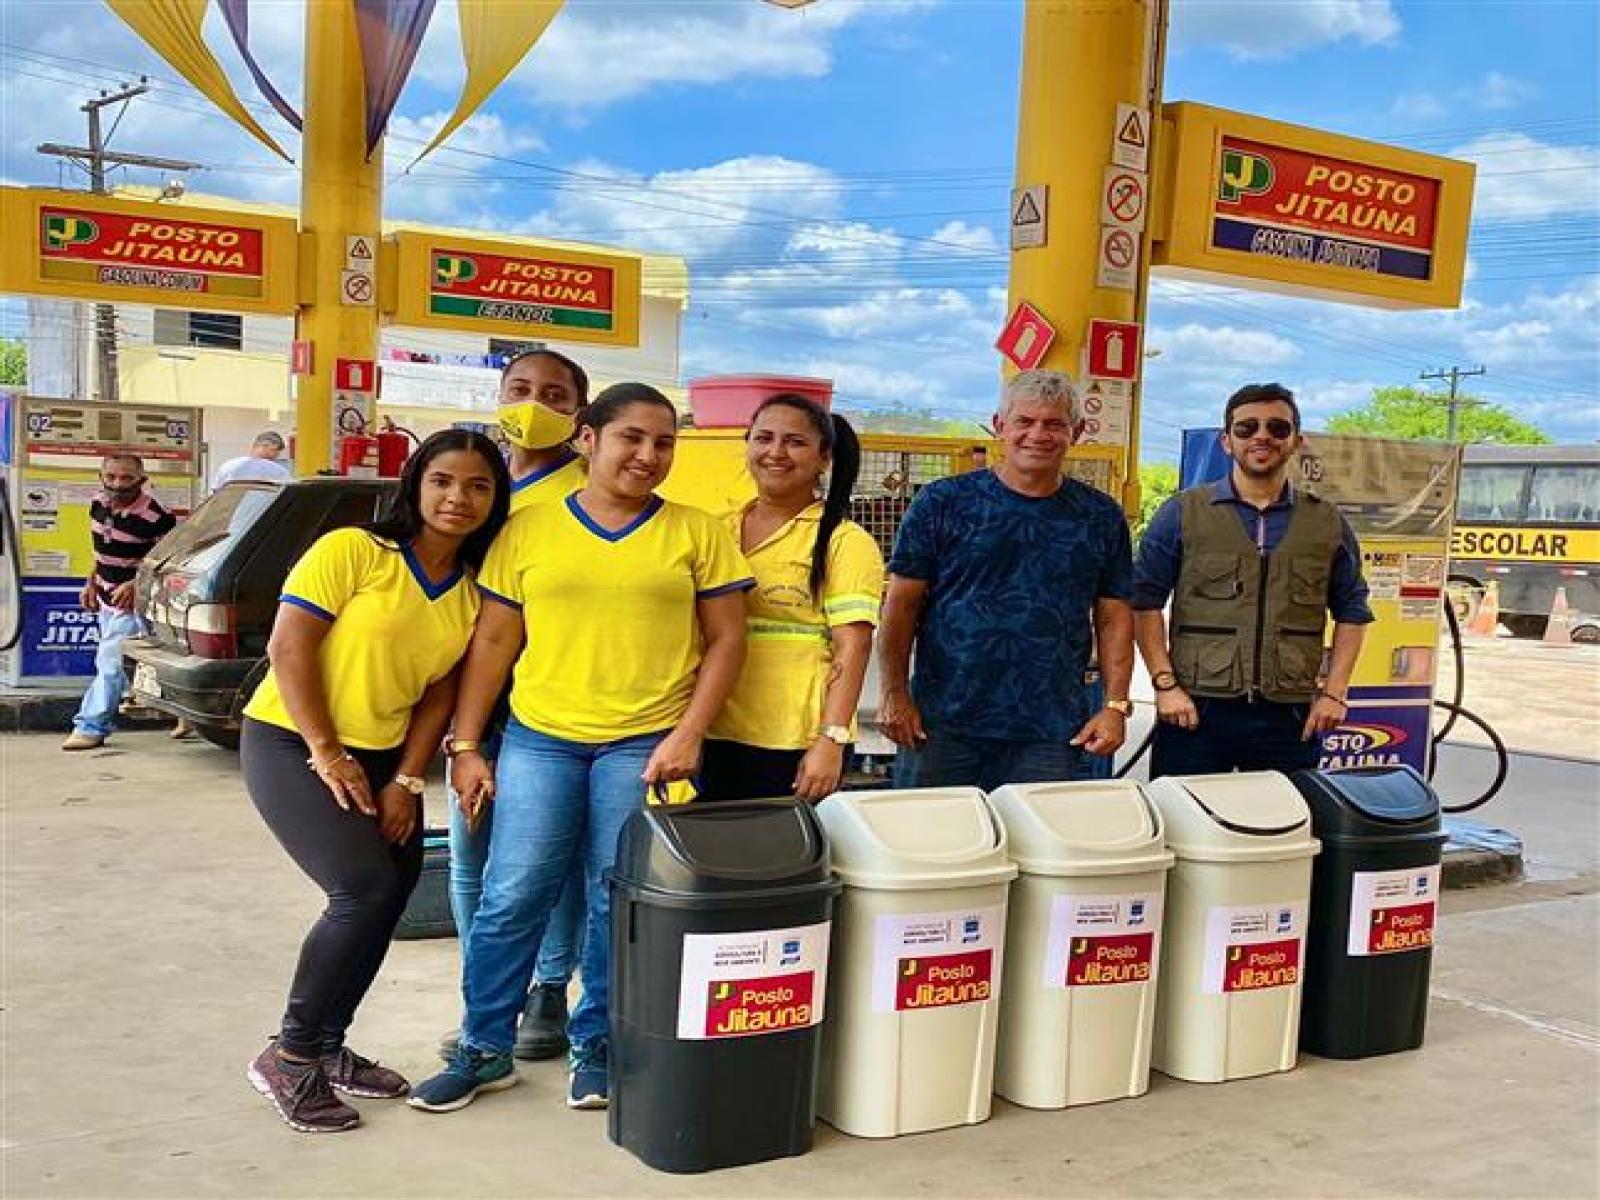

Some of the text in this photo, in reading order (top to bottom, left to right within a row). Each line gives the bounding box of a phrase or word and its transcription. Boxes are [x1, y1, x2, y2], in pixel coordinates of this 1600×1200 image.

[1305, 164, 1416, 205] POSTO
[1275, 192, 1417, 237] JITAÚNA
[128, 222, 240, 246] POSTO
[103, 241, 244, 268] JITAÚNA
[102, 267, 158, 287] GASOLINA
[502, 262, 593, 285] POSTO
[480, 279, 597, 304] JITAÚNA
[1451, 532, 1568, 556] ESCOLAR
[47, 612, 99, 624] POST
[42, 627, 100, 643] JITA
[1322, 734, 1365, 753] STO
[1097, 945, 1138, 960] Posto
[928, 964, 974, 981] Posto
[742, 986, 793, 1006] Posto
[717, 1004, 811, 1033] Jitaúna
